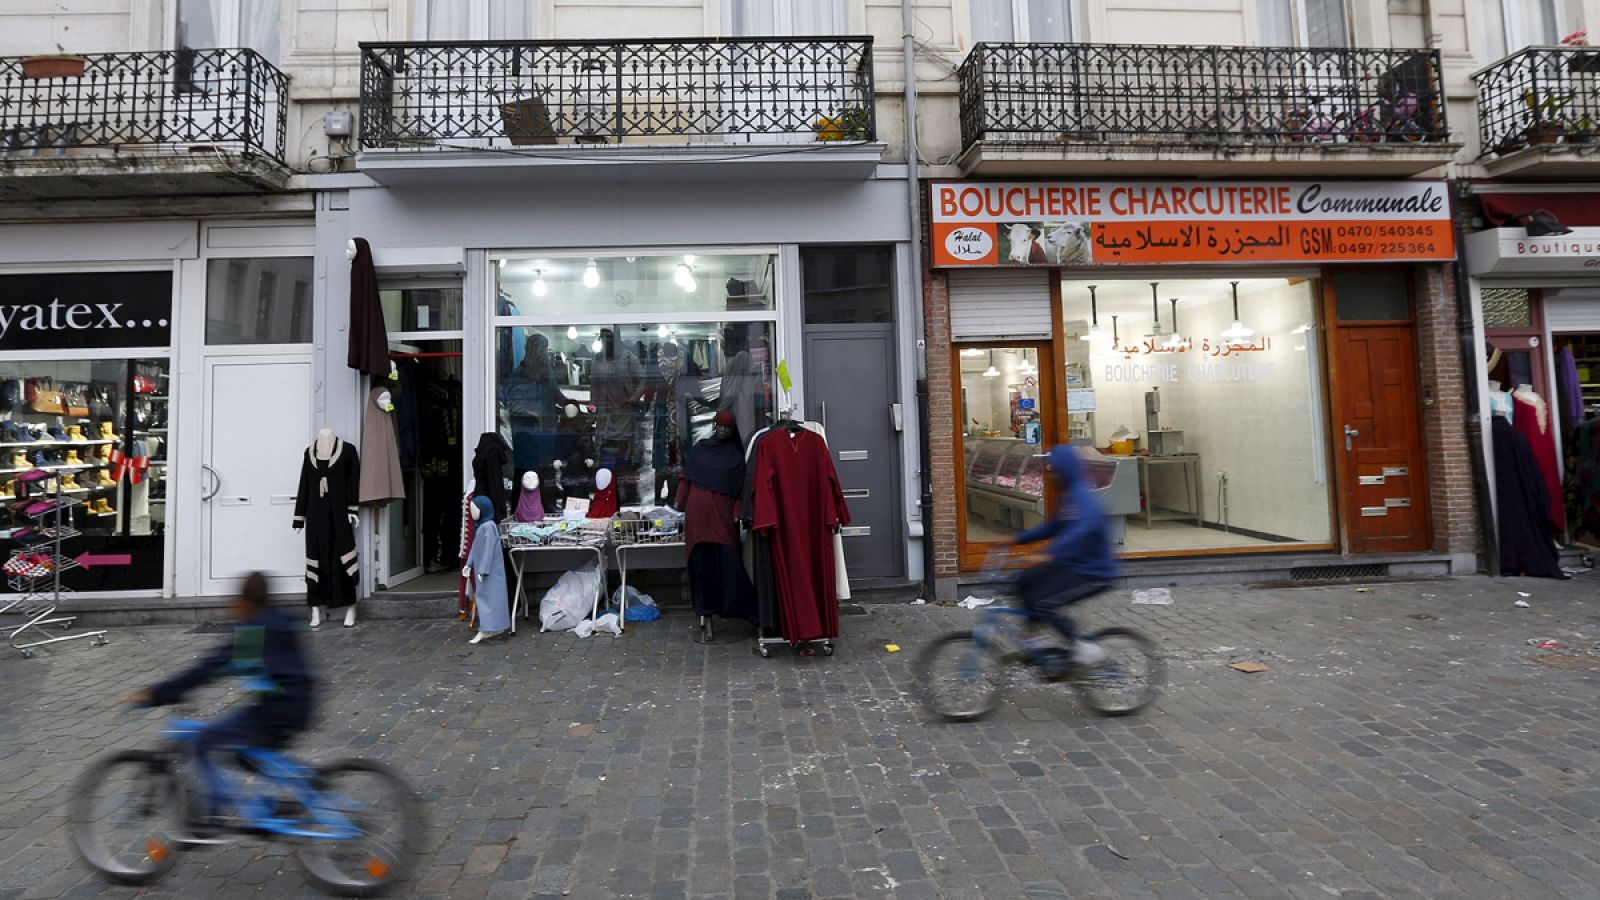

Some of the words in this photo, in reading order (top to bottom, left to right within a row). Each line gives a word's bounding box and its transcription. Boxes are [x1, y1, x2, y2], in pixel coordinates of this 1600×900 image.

[940, 187, 1101, 217] BOUCHERIE
[1109, 186, 1291, 216] CHARCUTERIE
[1296, 183, 1443, 214] Communale
[953, 230, 982, 243] Halal
[1206, 224, 1290, 255] المجزرة
